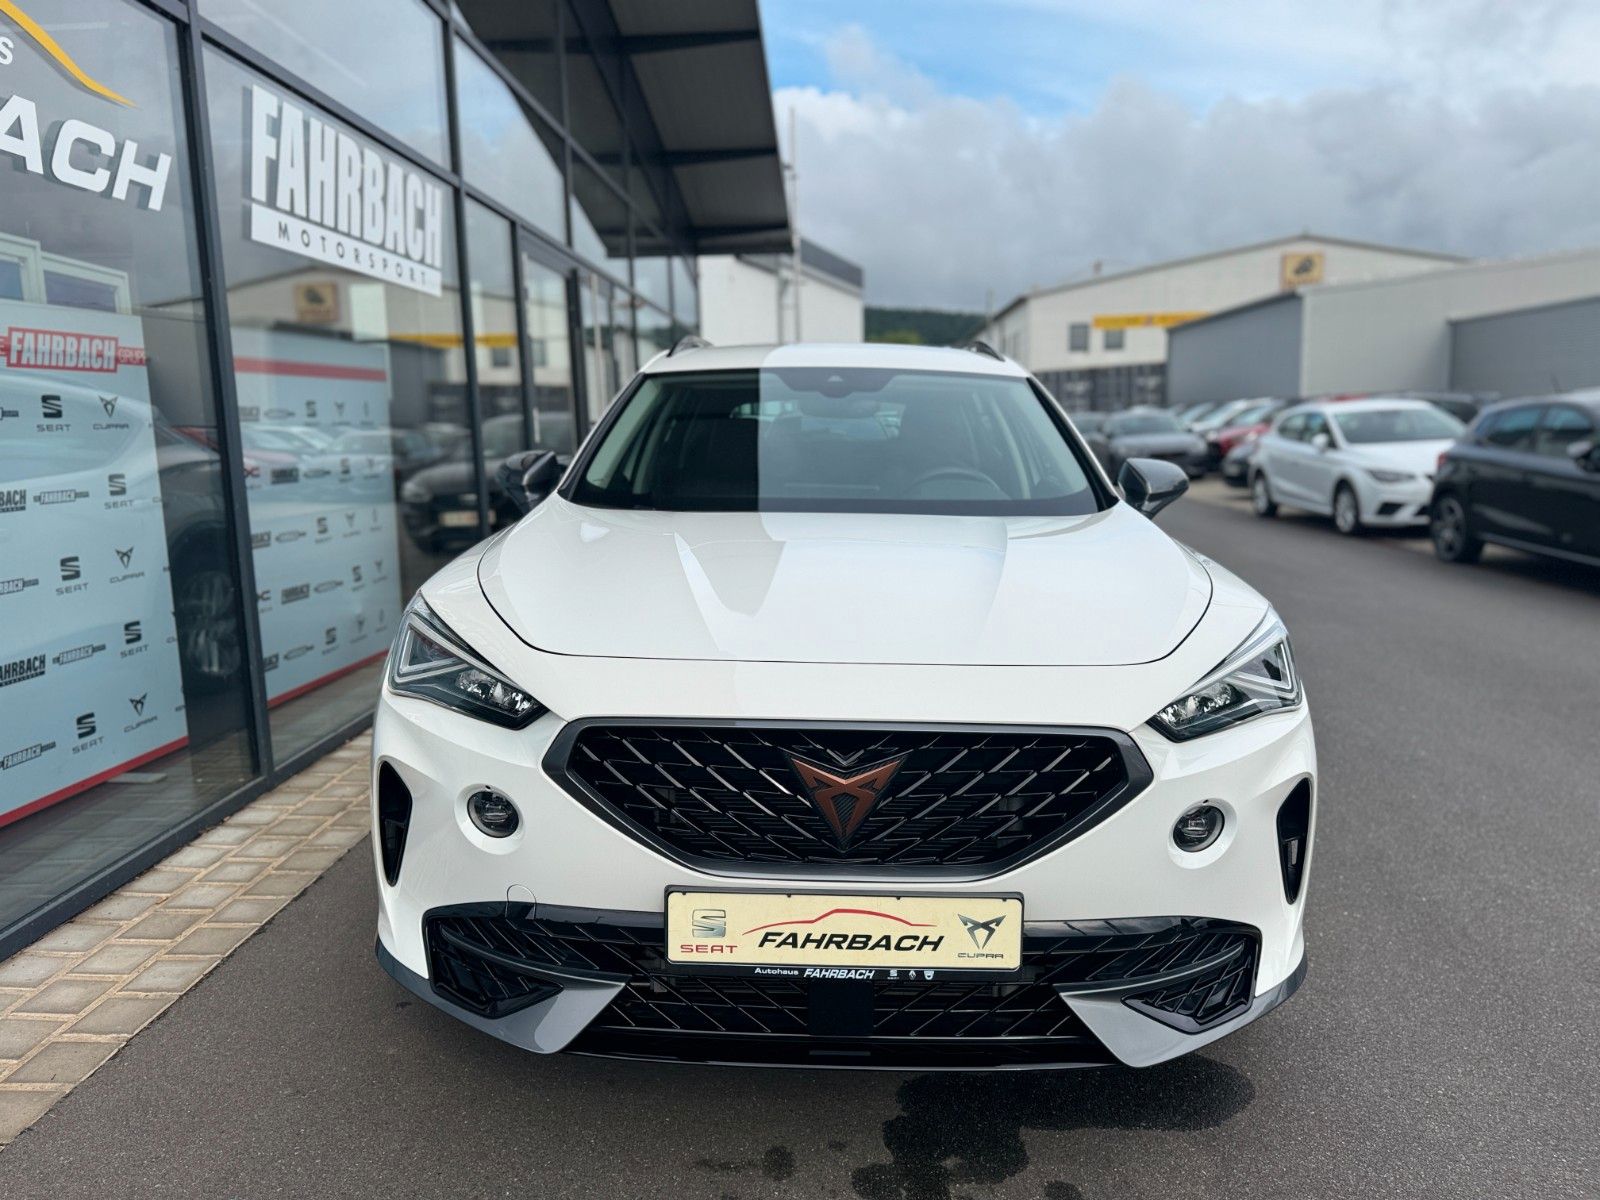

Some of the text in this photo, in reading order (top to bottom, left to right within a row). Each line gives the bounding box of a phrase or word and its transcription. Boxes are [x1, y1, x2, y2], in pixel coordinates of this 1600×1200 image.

[0, 94, 172, 212] ACH
[251, 84, 443, 269] FAHRBACH
[278, 221, 426, 285] MOTORSPORT
[9, 330, 117, 370] FAHRBACH
[36, 424, 71, 432] SEAT
[104, 500, 134, 510] SEAT
[109, 572, 145, 584] CUPRA
[56, 583, 89, 595] SEAT
[120, 645, 149, 658] SEAT
[124, 716, 158, 733] CUPRA
[72, 737, 104, 754] SEAT
[680, 944, 738, 953] SEAT
[758, 931, 945, 952] FAHRBACH
[754, 967, 875, 979] Autohaus FAHRBACH
